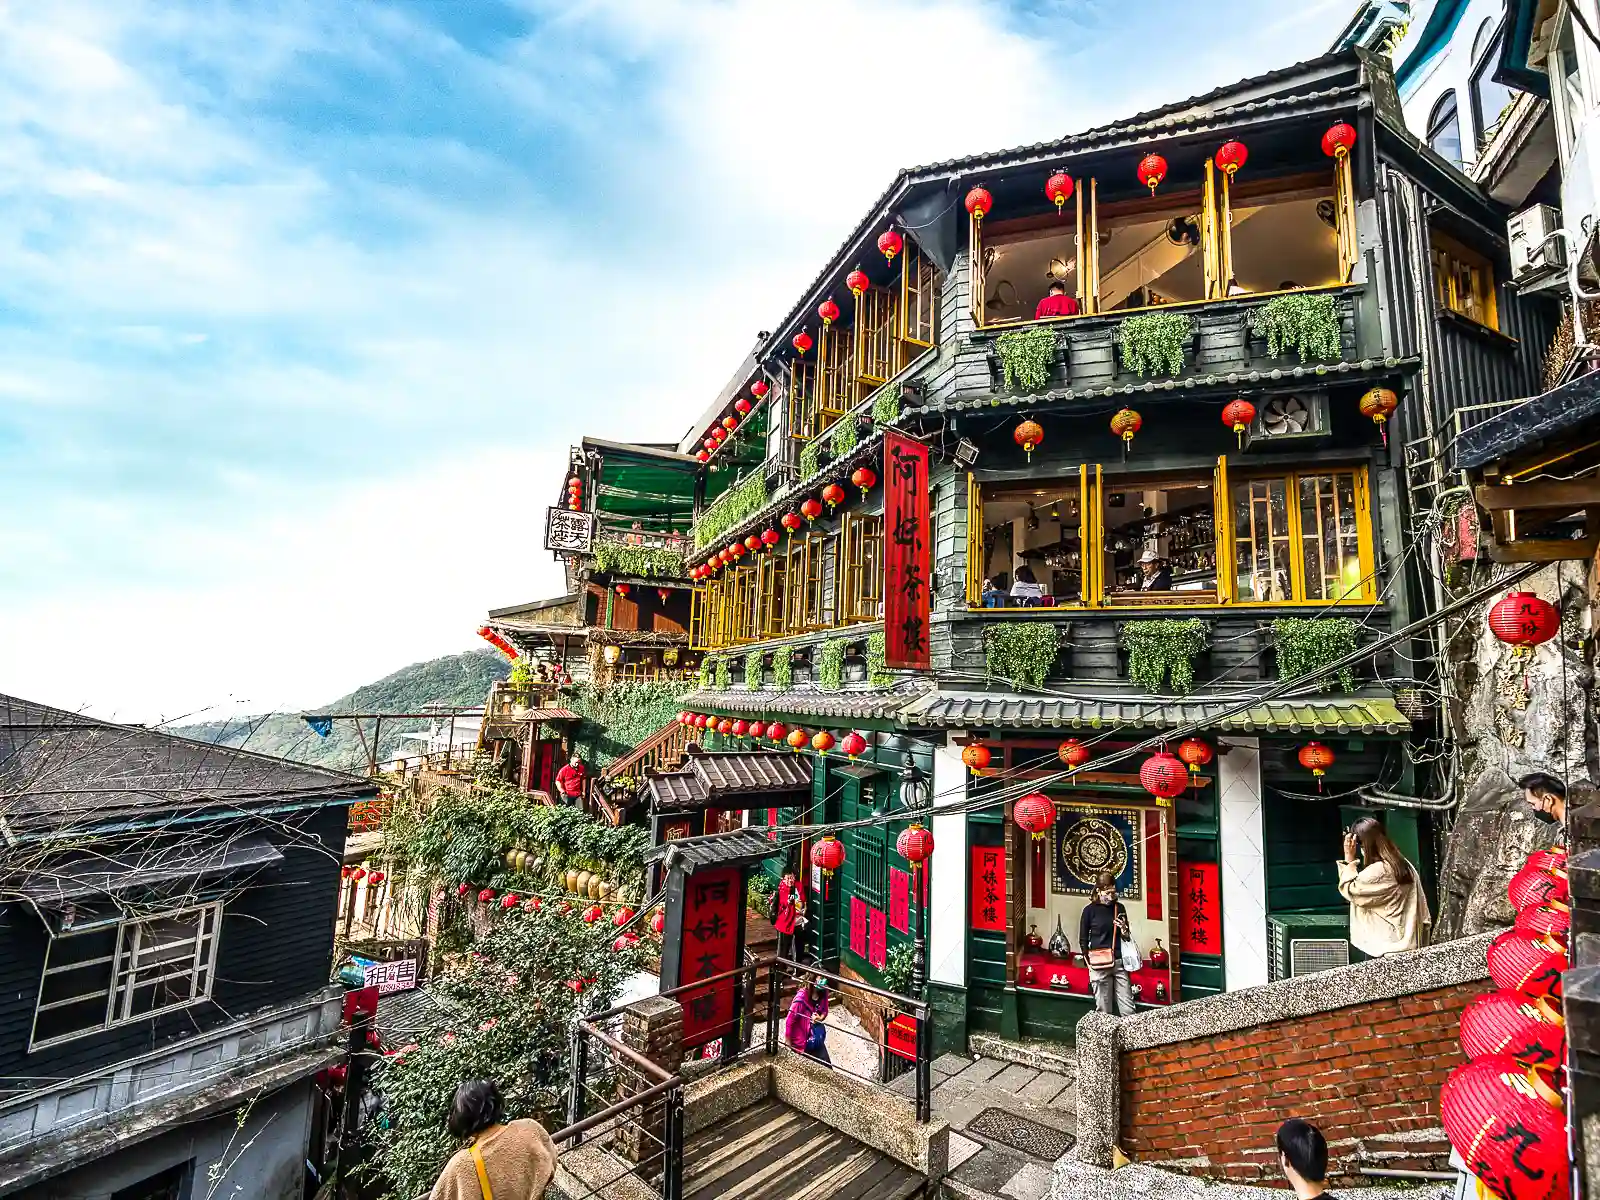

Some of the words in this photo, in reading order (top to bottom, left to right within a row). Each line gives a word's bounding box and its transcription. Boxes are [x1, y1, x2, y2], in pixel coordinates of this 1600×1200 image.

[892, 445, 926, 654] 阿妹茶樓
[982, 852, 1000, 922] 阿妹茶樓
[1189, 868, 1208, 946] 阿妹茶樓
